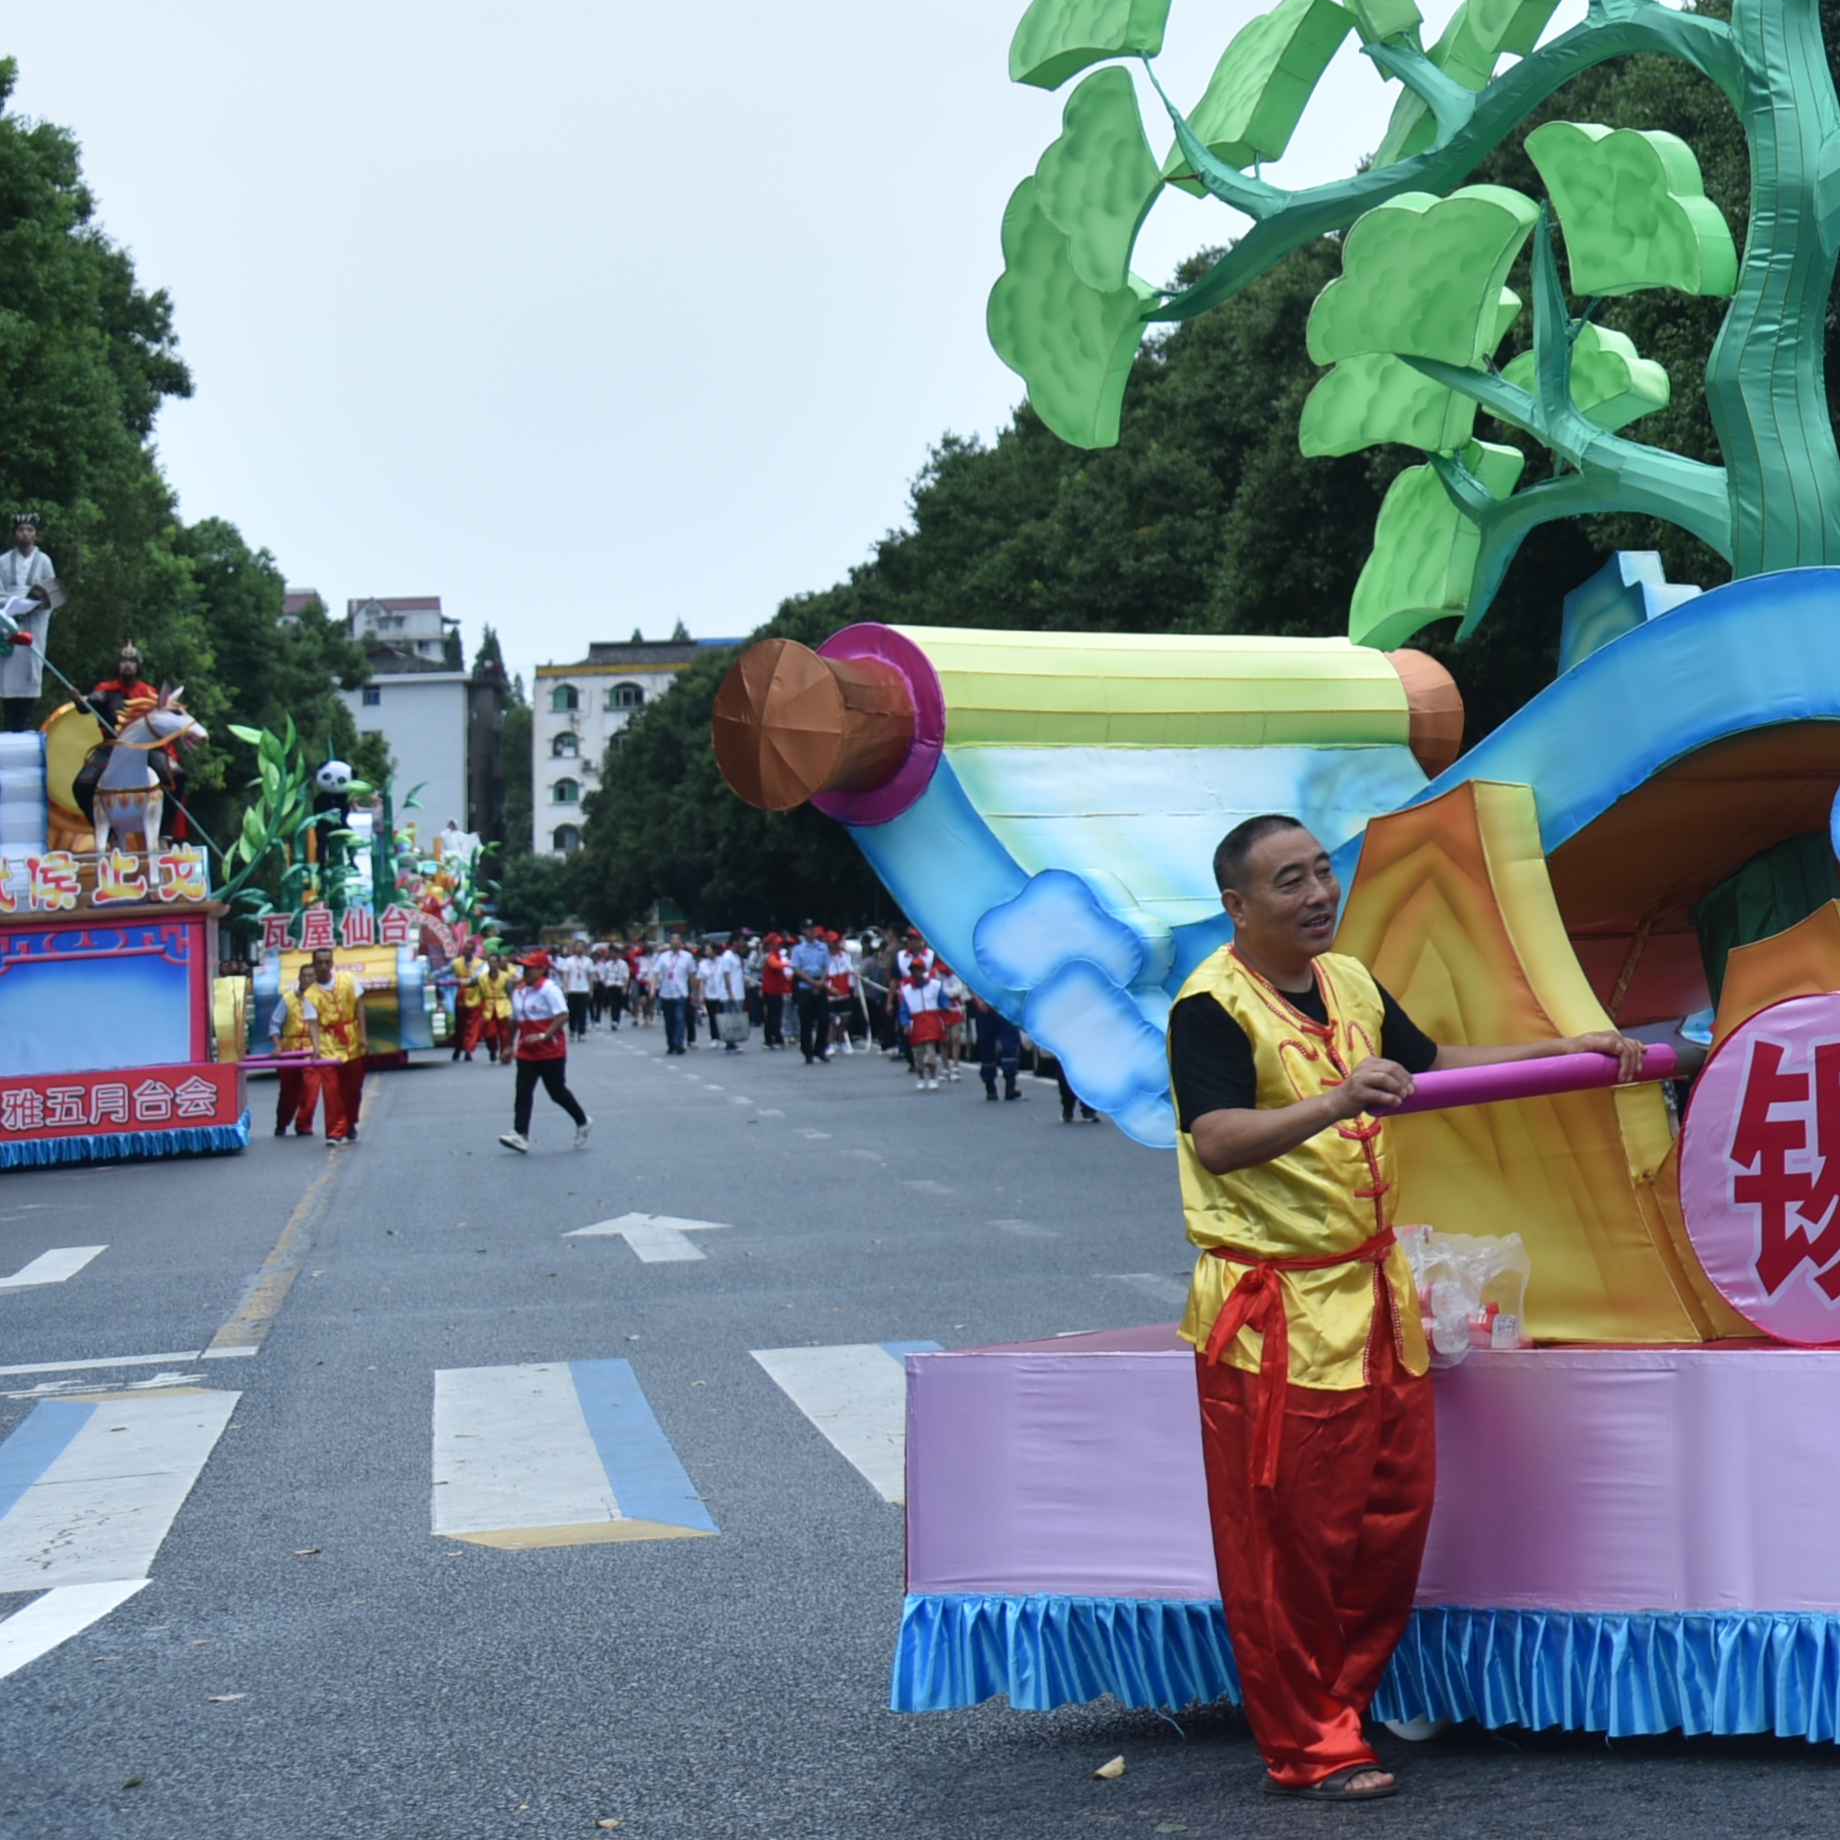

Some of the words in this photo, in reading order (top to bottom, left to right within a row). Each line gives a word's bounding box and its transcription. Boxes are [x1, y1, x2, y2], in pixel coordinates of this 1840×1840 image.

[258, 904, 411, 953] 瓦屋仙台
[1, 1076, 216, 1130] 雅五月台会
